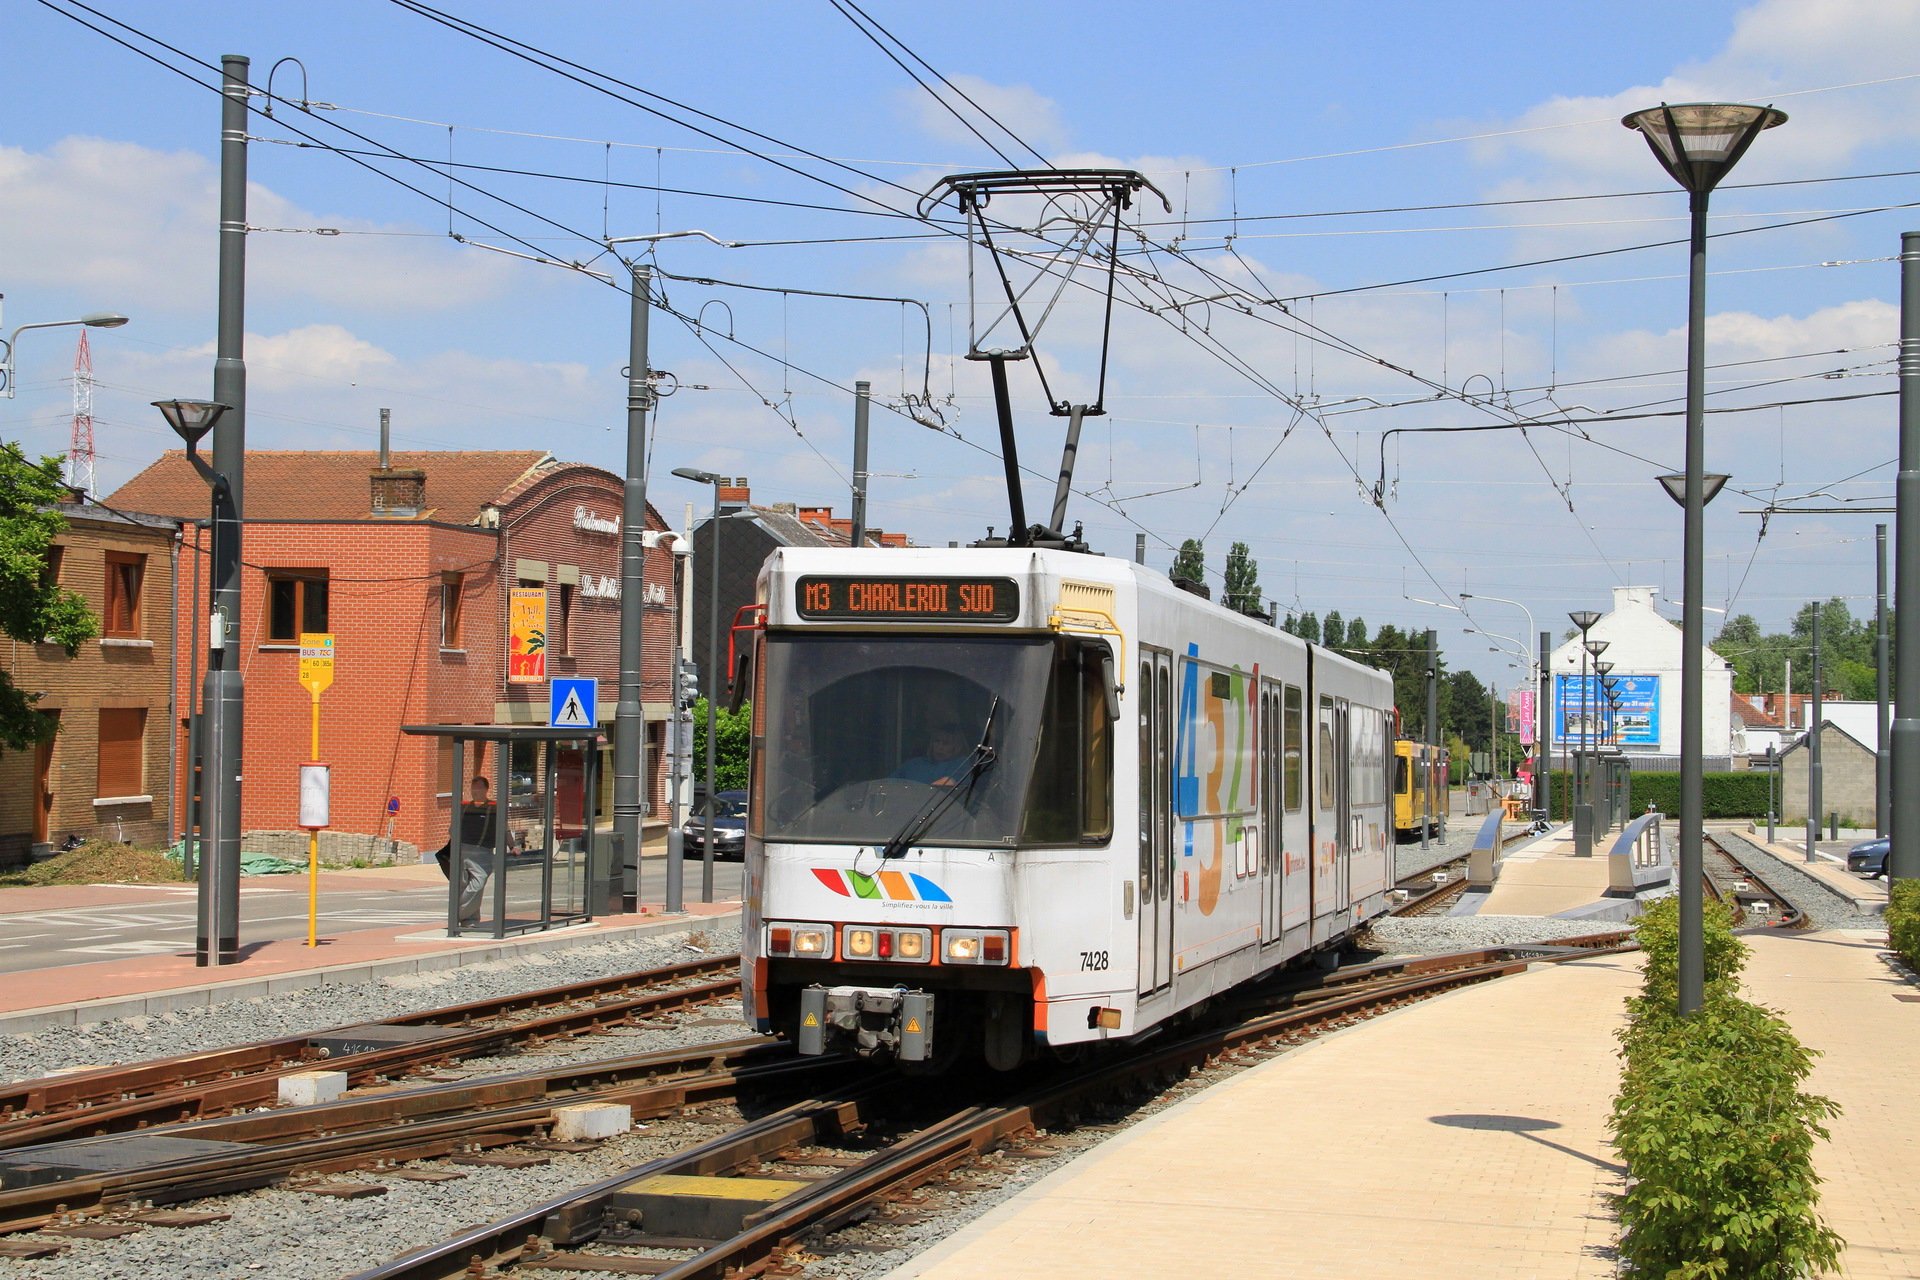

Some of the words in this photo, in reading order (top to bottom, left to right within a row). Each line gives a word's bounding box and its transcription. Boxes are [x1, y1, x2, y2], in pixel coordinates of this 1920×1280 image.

[805, 583, 830, 610] M3
[849, 584, 948, 612] CHARLEROI
[959, 584, 994, 612] SUD
[987, 852, 995, 862] A
[881, 901, 931, 910] Simplifiez-vous
[1080, 951, 1109, 972] 7428
